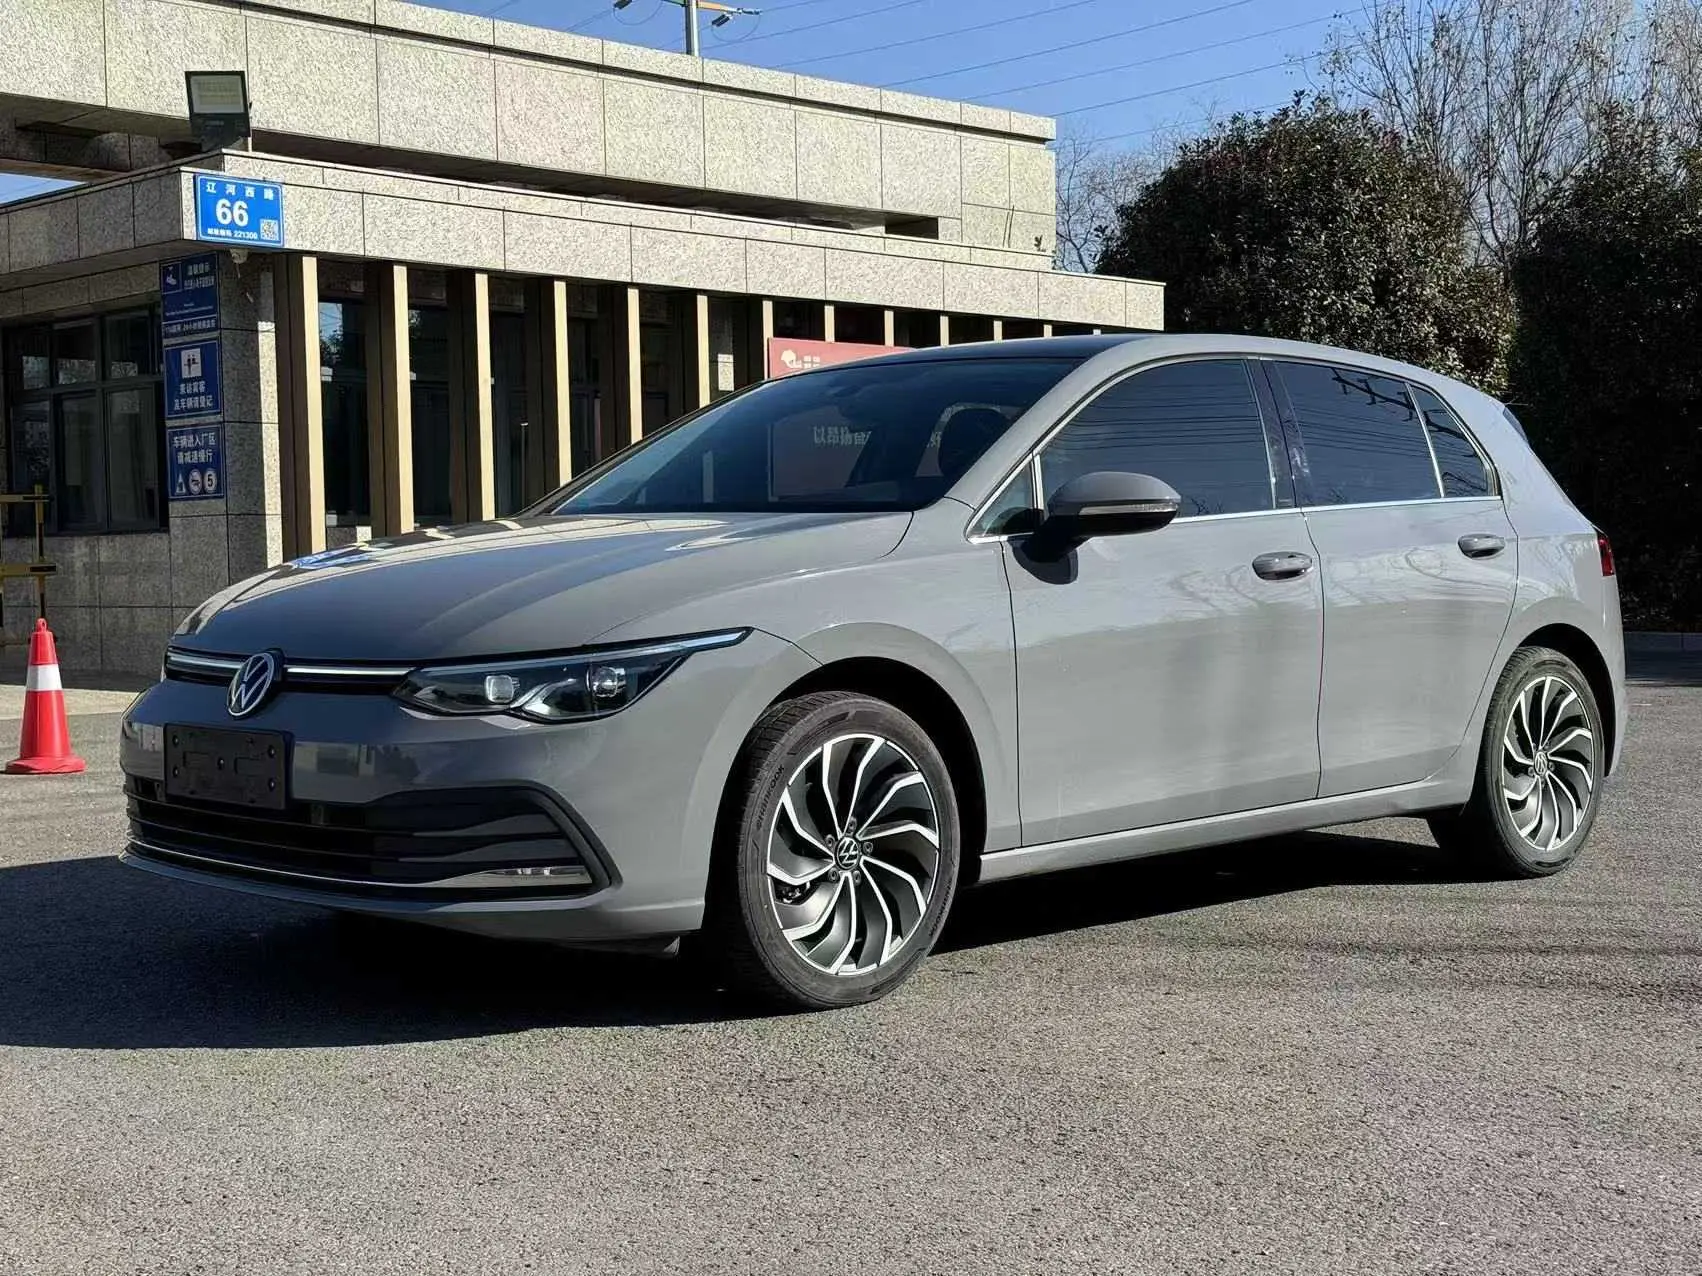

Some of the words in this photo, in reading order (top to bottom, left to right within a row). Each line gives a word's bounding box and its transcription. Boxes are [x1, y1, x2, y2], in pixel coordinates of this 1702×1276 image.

[216, 198, 249, 227] 66
[173, 432, 216, 448] 车辆进入厂区
[207, 473, 214, 488] 5
